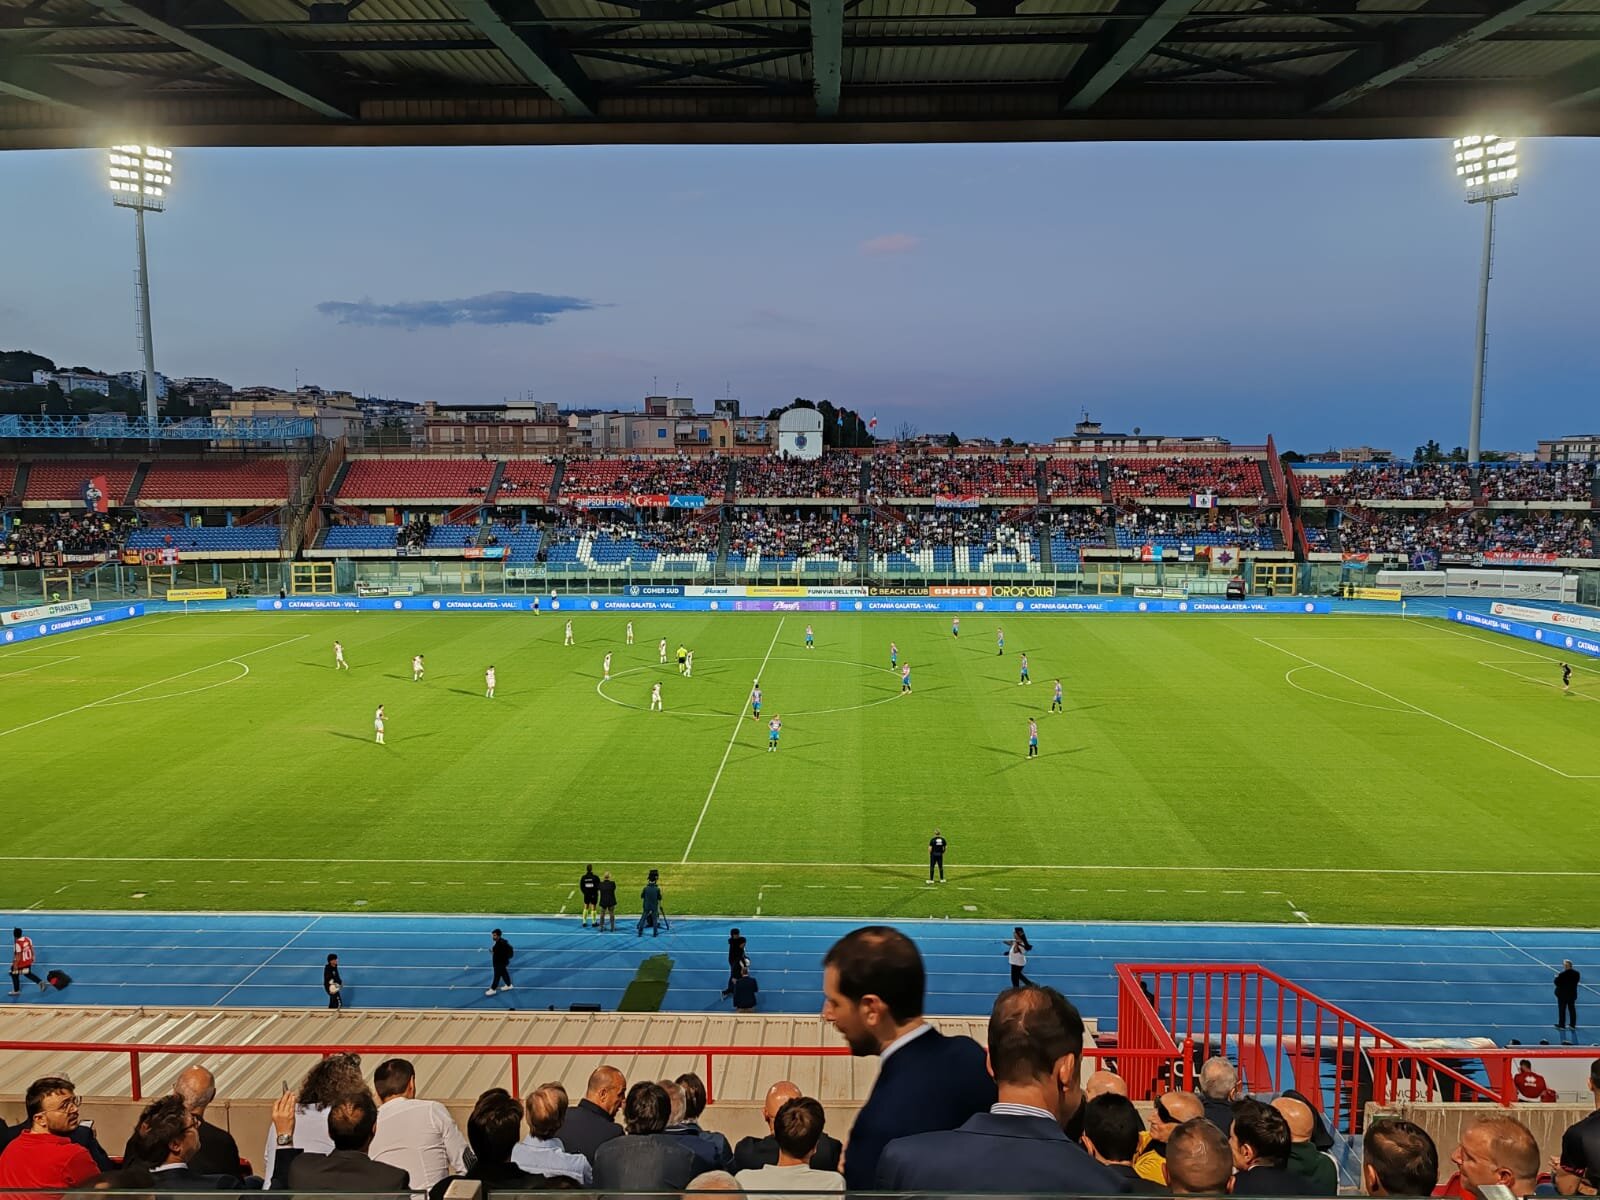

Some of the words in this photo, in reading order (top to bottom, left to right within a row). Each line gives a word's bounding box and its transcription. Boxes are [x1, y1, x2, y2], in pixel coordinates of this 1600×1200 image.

[606, 498, 625, 507] BOYS
[807, 587, 833, 595] FUNIVIA
[934, 587, 977, 595] expert
